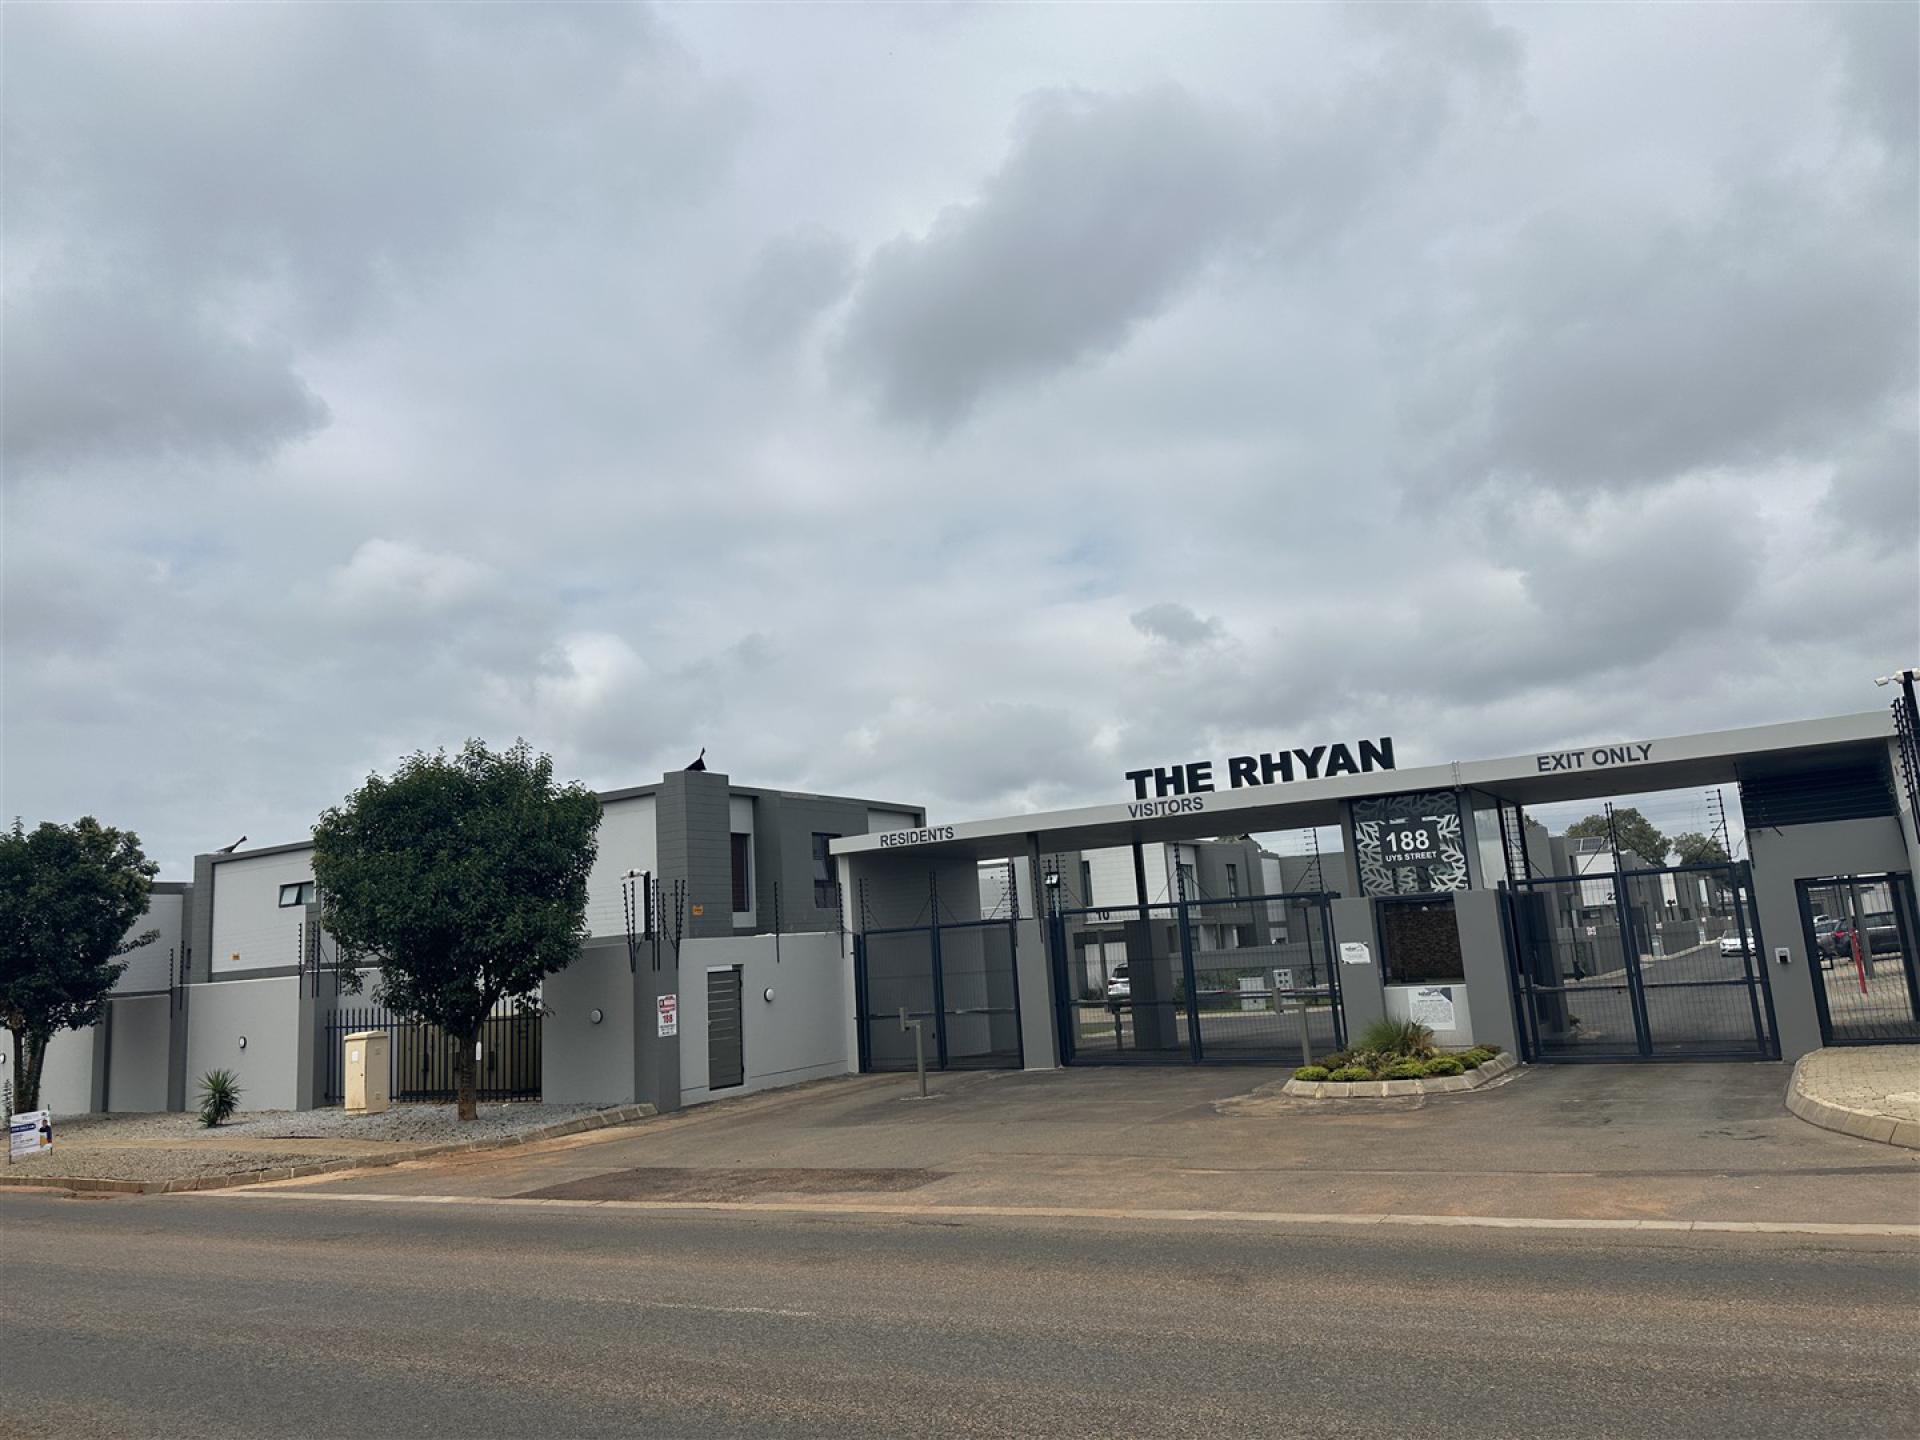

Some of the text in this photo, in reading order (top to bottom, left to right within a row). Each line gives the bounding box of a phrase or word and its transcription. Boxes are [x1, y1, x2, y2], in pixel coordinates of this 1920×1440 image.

[1125, 737, 1396, 800] THE RHYAN
[1536, 743, 1652, 772] EXIT ONLY
[1128, 797, 1204, 818] VISITORS
[880, 826, 954, 847] RESIDENTS
[1386, 829, 1429, 852] 188
[1385, 851, 1437, 862] UYS STREET
